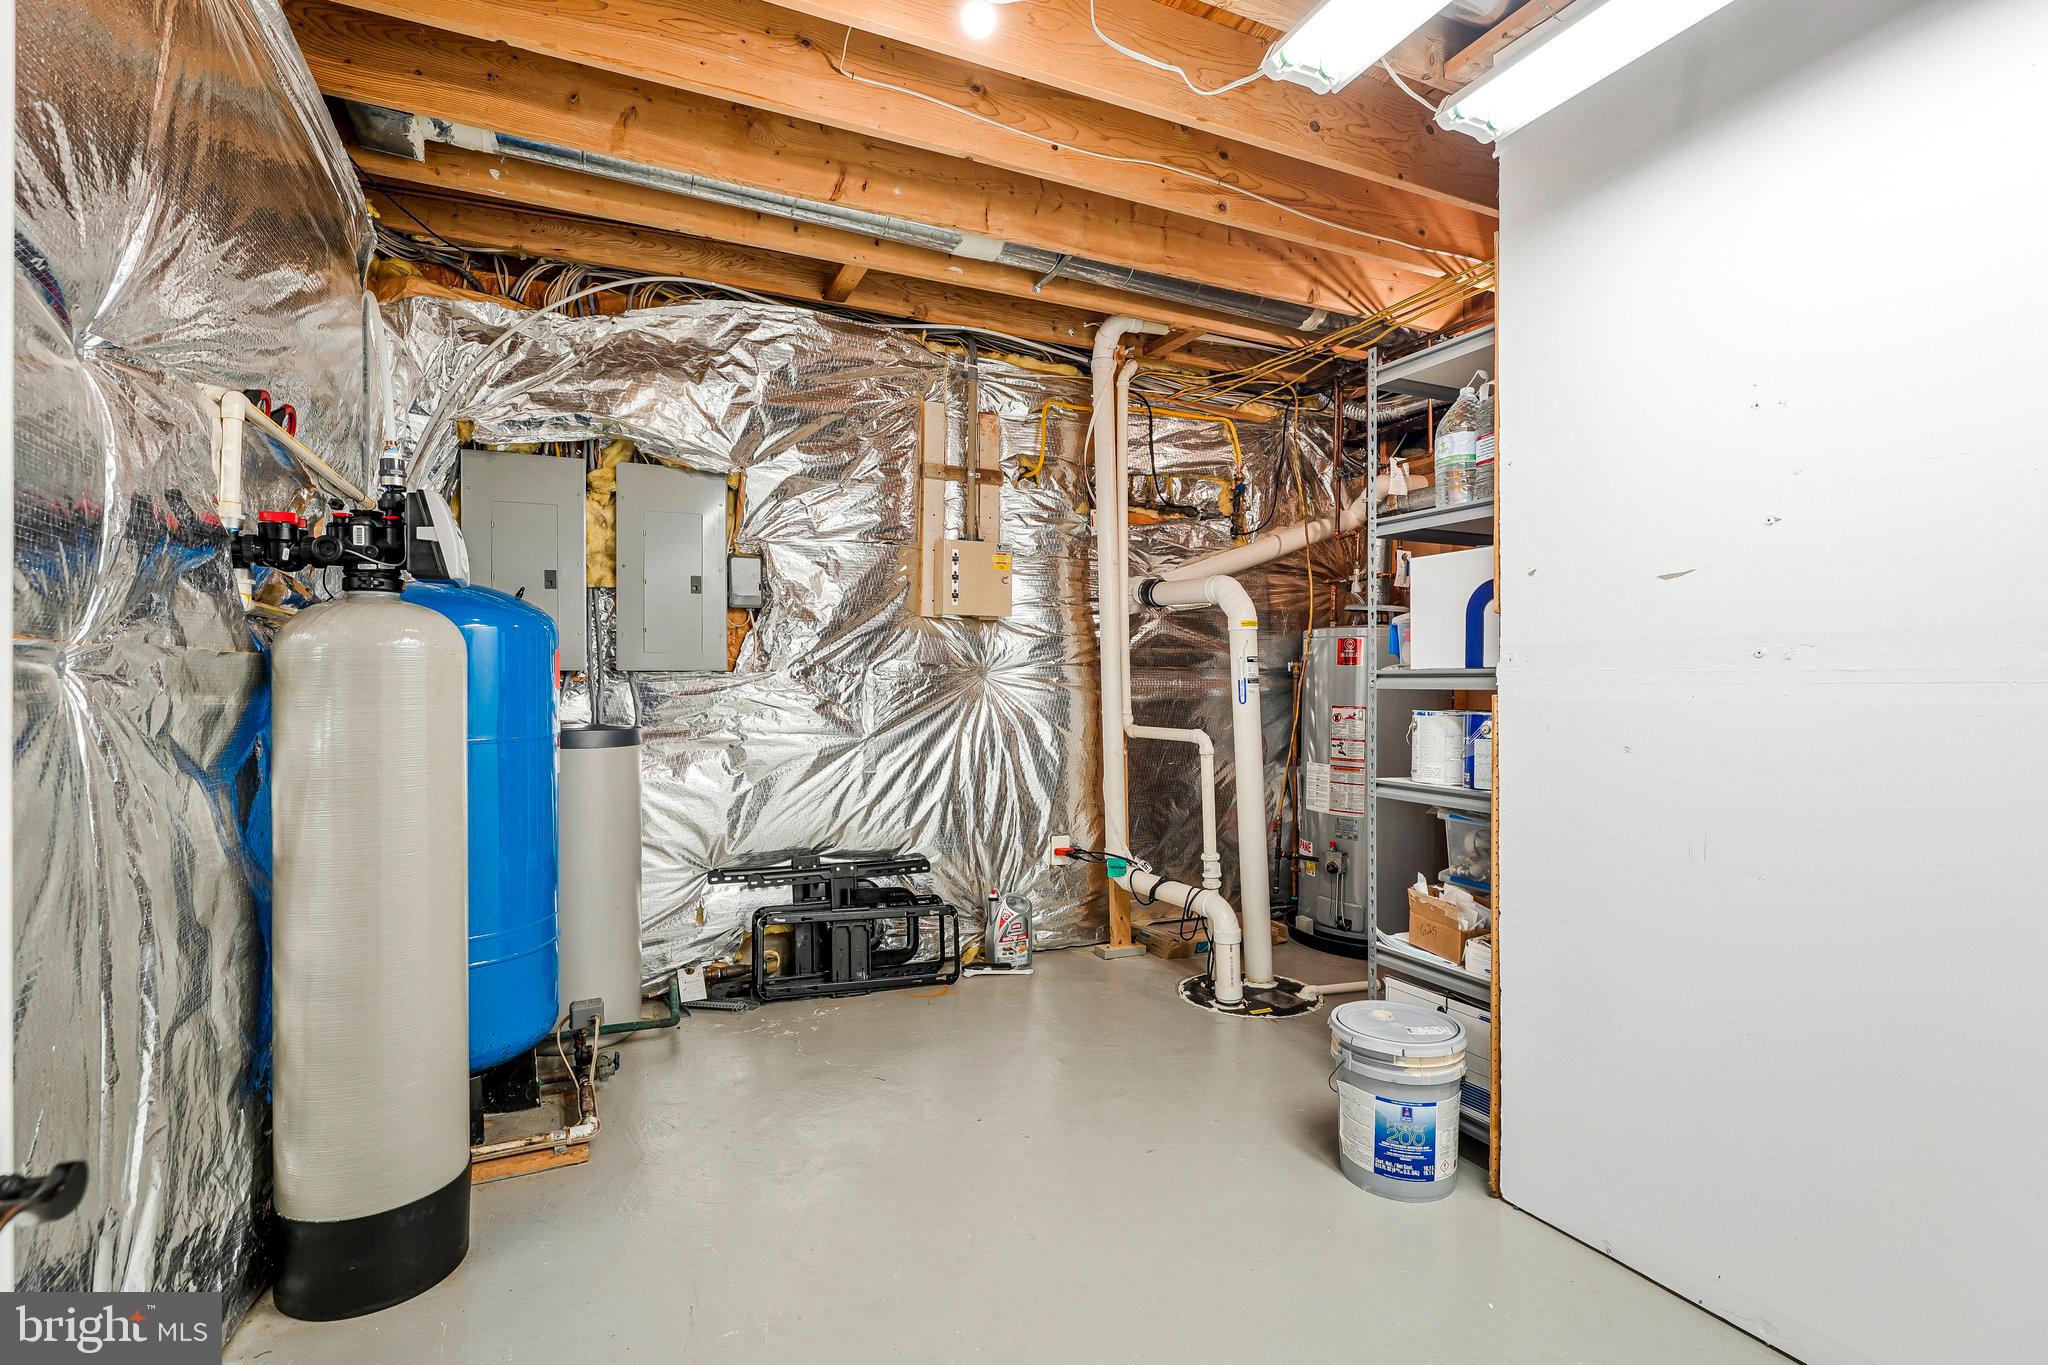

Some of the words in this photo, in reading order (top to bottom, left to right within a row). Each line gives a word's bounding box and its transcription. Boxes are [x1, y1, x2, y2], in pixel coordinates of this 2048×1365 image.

[1299, 840, 1312, 853] PANE
[1420, 923, 1437, 941] 625
[1386, 1127, 1426, 1147] 200
